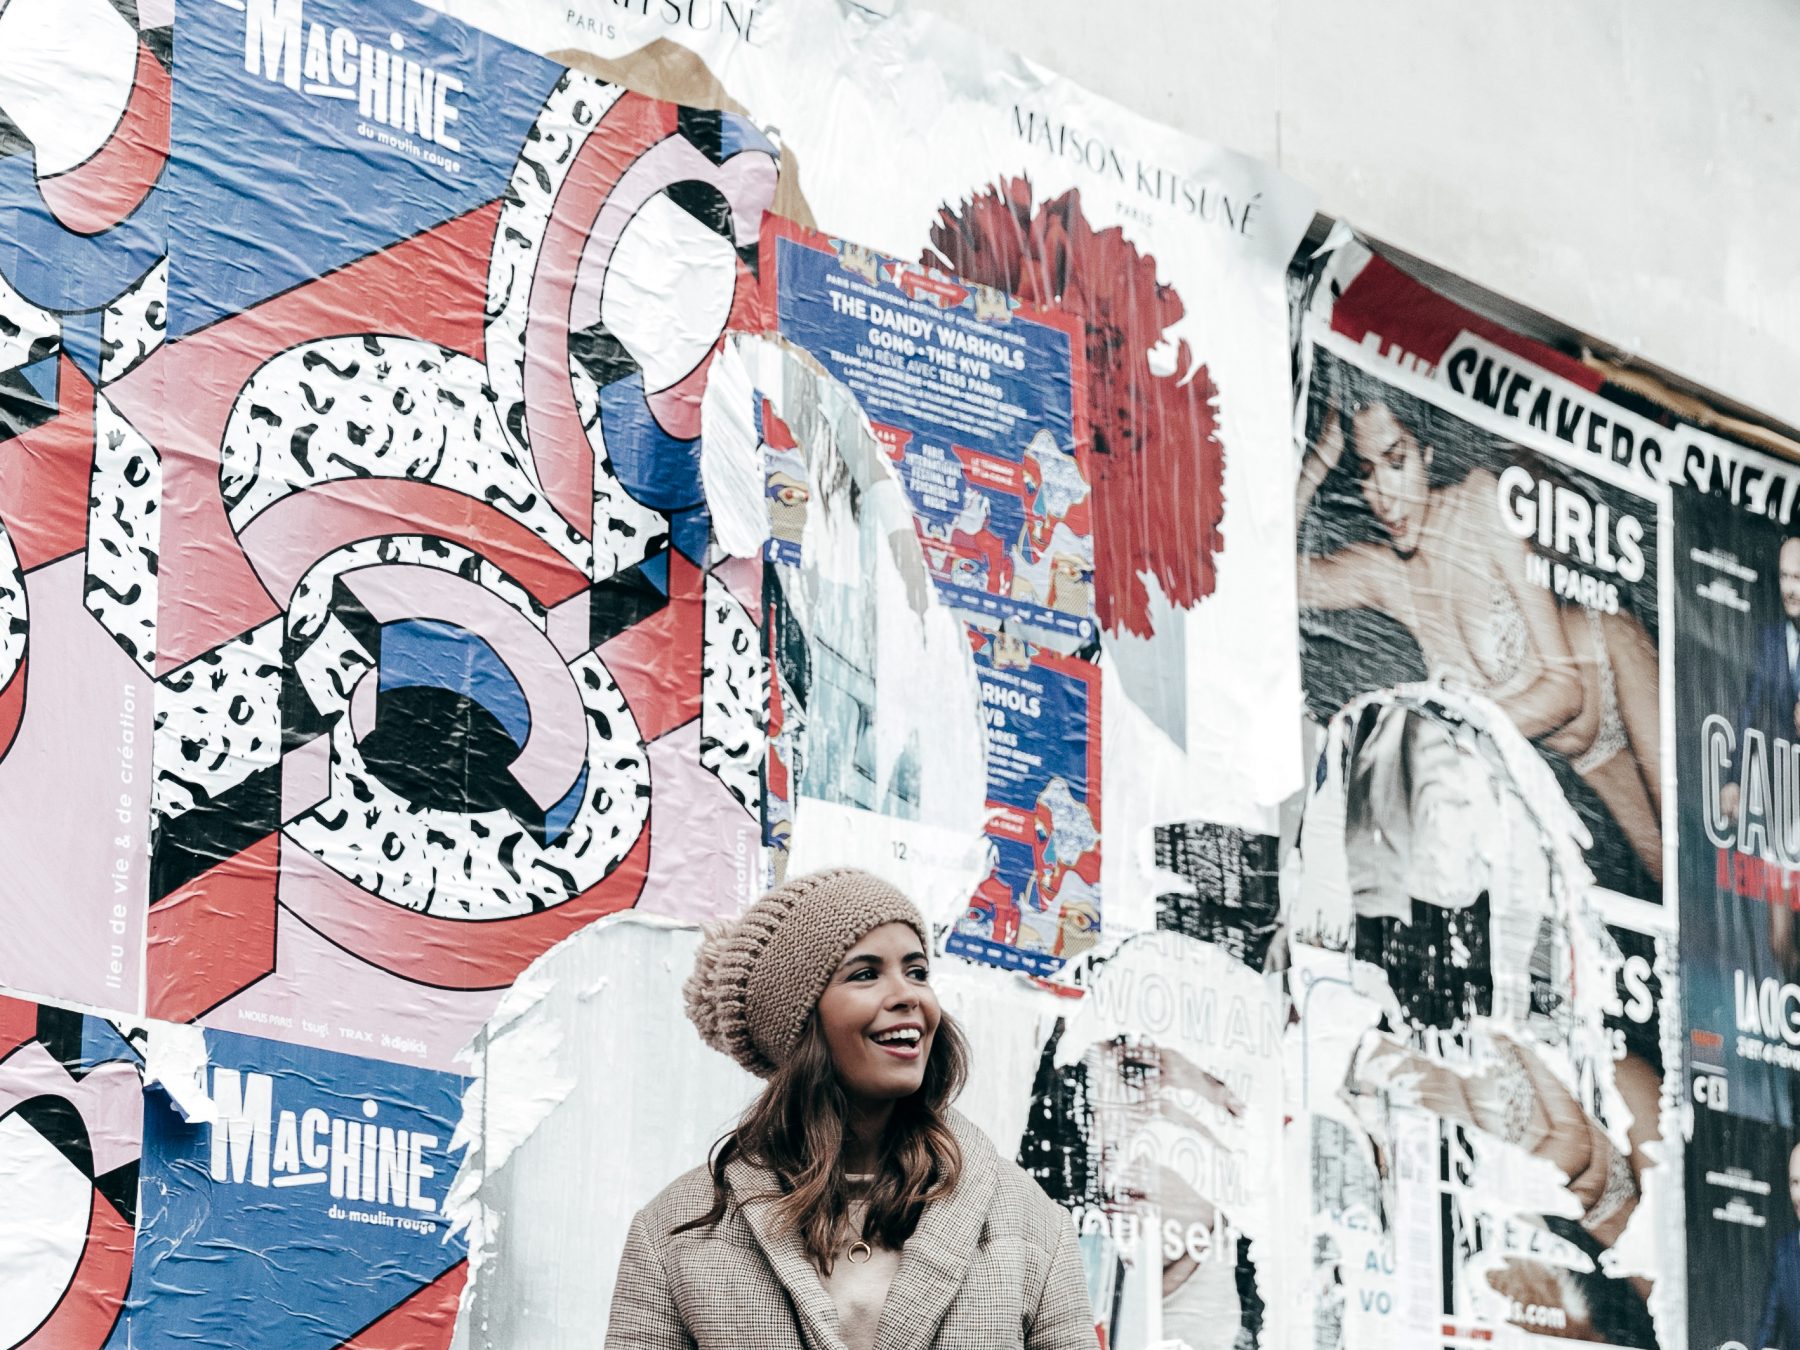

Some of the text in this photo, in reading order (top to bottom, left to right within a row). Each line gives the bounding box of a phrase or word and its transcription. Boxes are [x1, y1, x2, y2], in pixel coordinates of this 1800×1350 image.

[566, 10, 616, 40] PARIS
[357, 122, 462, 174] du moulin rouge
[1012, 105, 1263, 240] MAISON KITSUNÉ
[829, 289, 1026, 371] THE DANDY WARHOLS
[868, 327, 992, 381] GONG THE KVB
[1496, 465, 1646, 584] GIRLS
[1525, 553, 1620, 616] IN PARIS
[981, 681, 1042, 719] RHOLS
[984, 706, 1007, 729] VB
[988, 727, 1019, 748] ARKS
[105, 683, 136, 989] lieu de vie & de création
[891, 841, 908, 861] 12
[339, 1026, 373, 1042] TRAX
[328, 1204, 437, 1235] du moulin rouge
